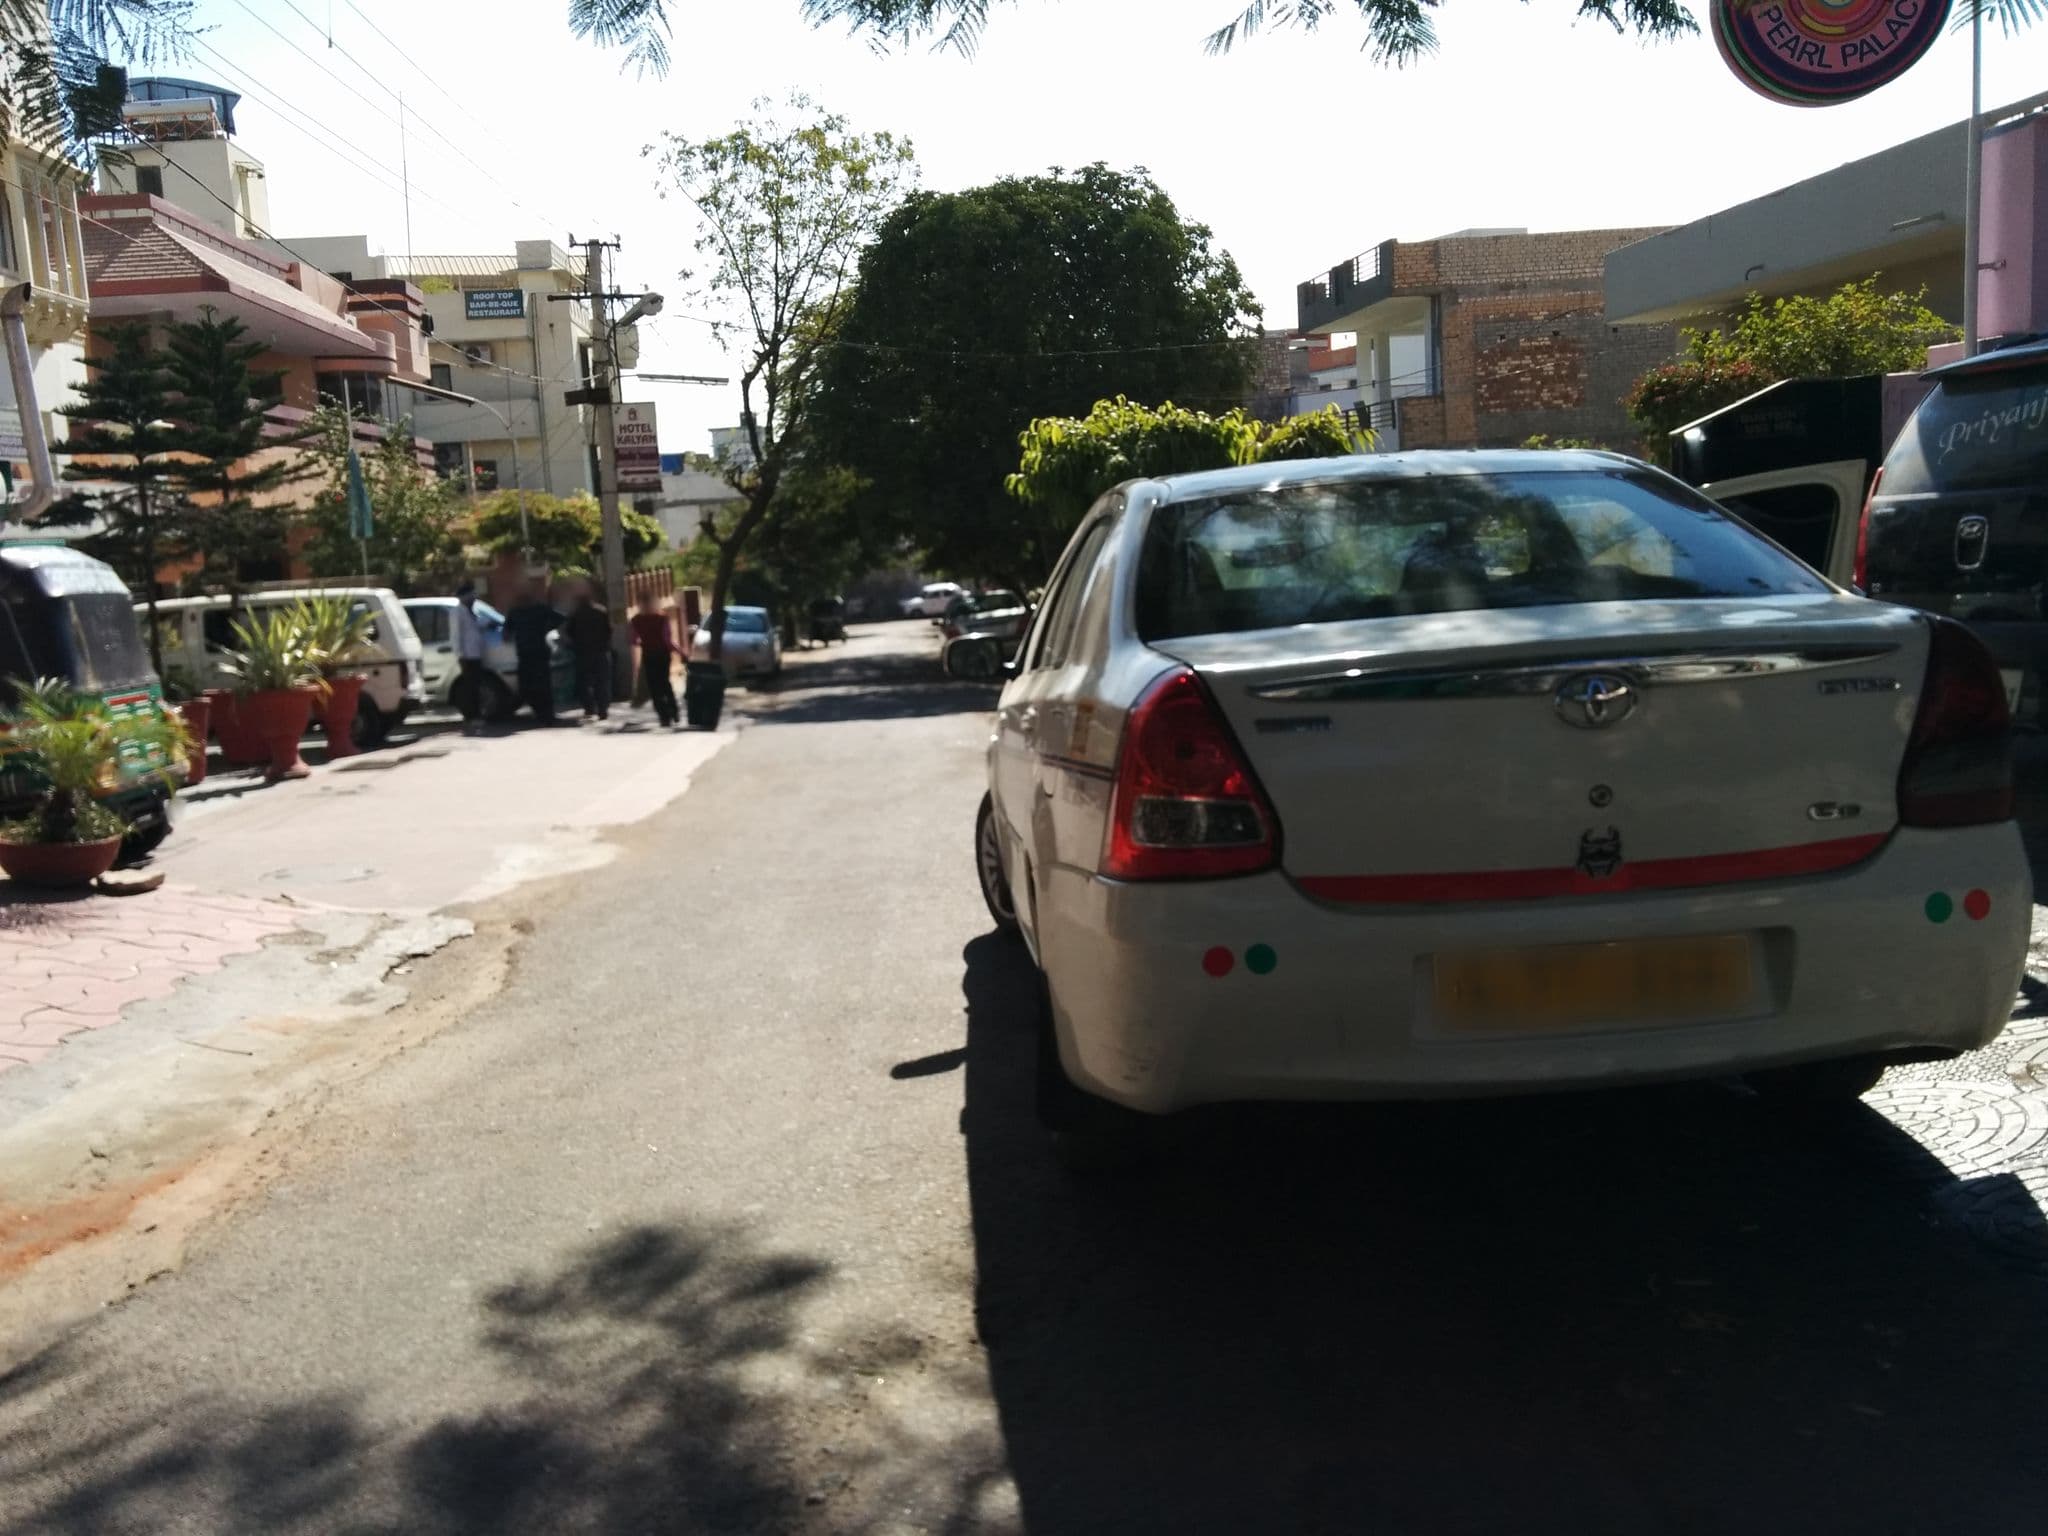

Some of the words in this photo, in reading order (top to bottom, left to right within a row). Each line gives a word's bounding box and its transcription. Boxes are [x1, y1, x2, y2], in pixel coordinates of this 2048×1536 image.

[1758, 5, 1832, 69] PEARL
[470, 300, 519, 309] BAR-BE-QUE
[619, 423, 652, 434] HOTEL
